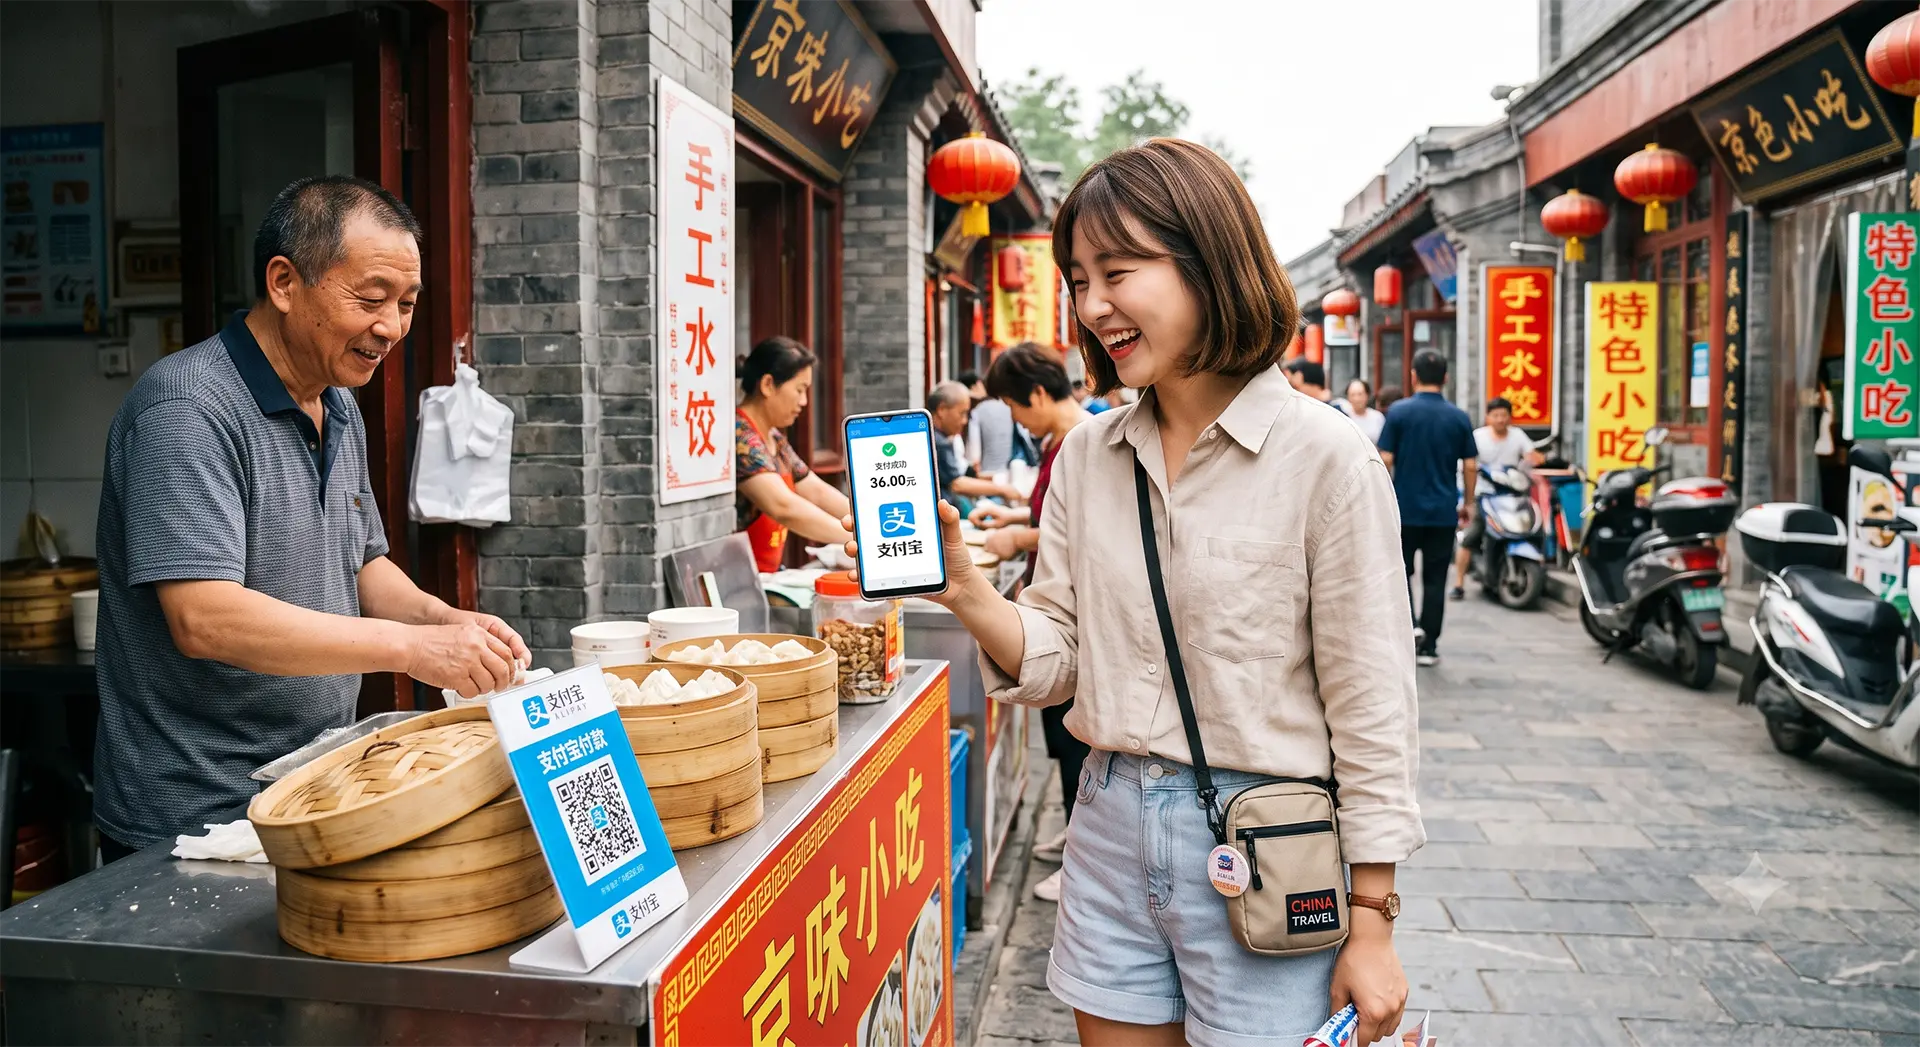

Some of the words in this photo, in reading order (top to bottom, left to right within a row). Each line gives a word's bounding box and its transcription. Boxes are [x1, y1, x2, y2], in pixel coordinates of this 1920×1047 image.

[685, 141, 716, 458] 手工水饺
[1865, 221, 1917, 426] 特色小吃
[1499, 275, 1542, 419] 手工水饺
[1598, 291, 1649, 479] 特色小吃
[874, 460, 907, 471] 支付成功
[877, 540, 923, 558] 支付宝
[546, 684, 585, 712] 支付宝
[555, 703, 587, 720] ALIPAY
[536, 728, 608, 775] 支付宝付款
[629, 893, 660, 924] 支付宝
[742, 767, 925, 1047] 京味小吃
[1291, 896, 1334, 913] CHINA
[1292, 912, 1335, 926] TRAVEL
